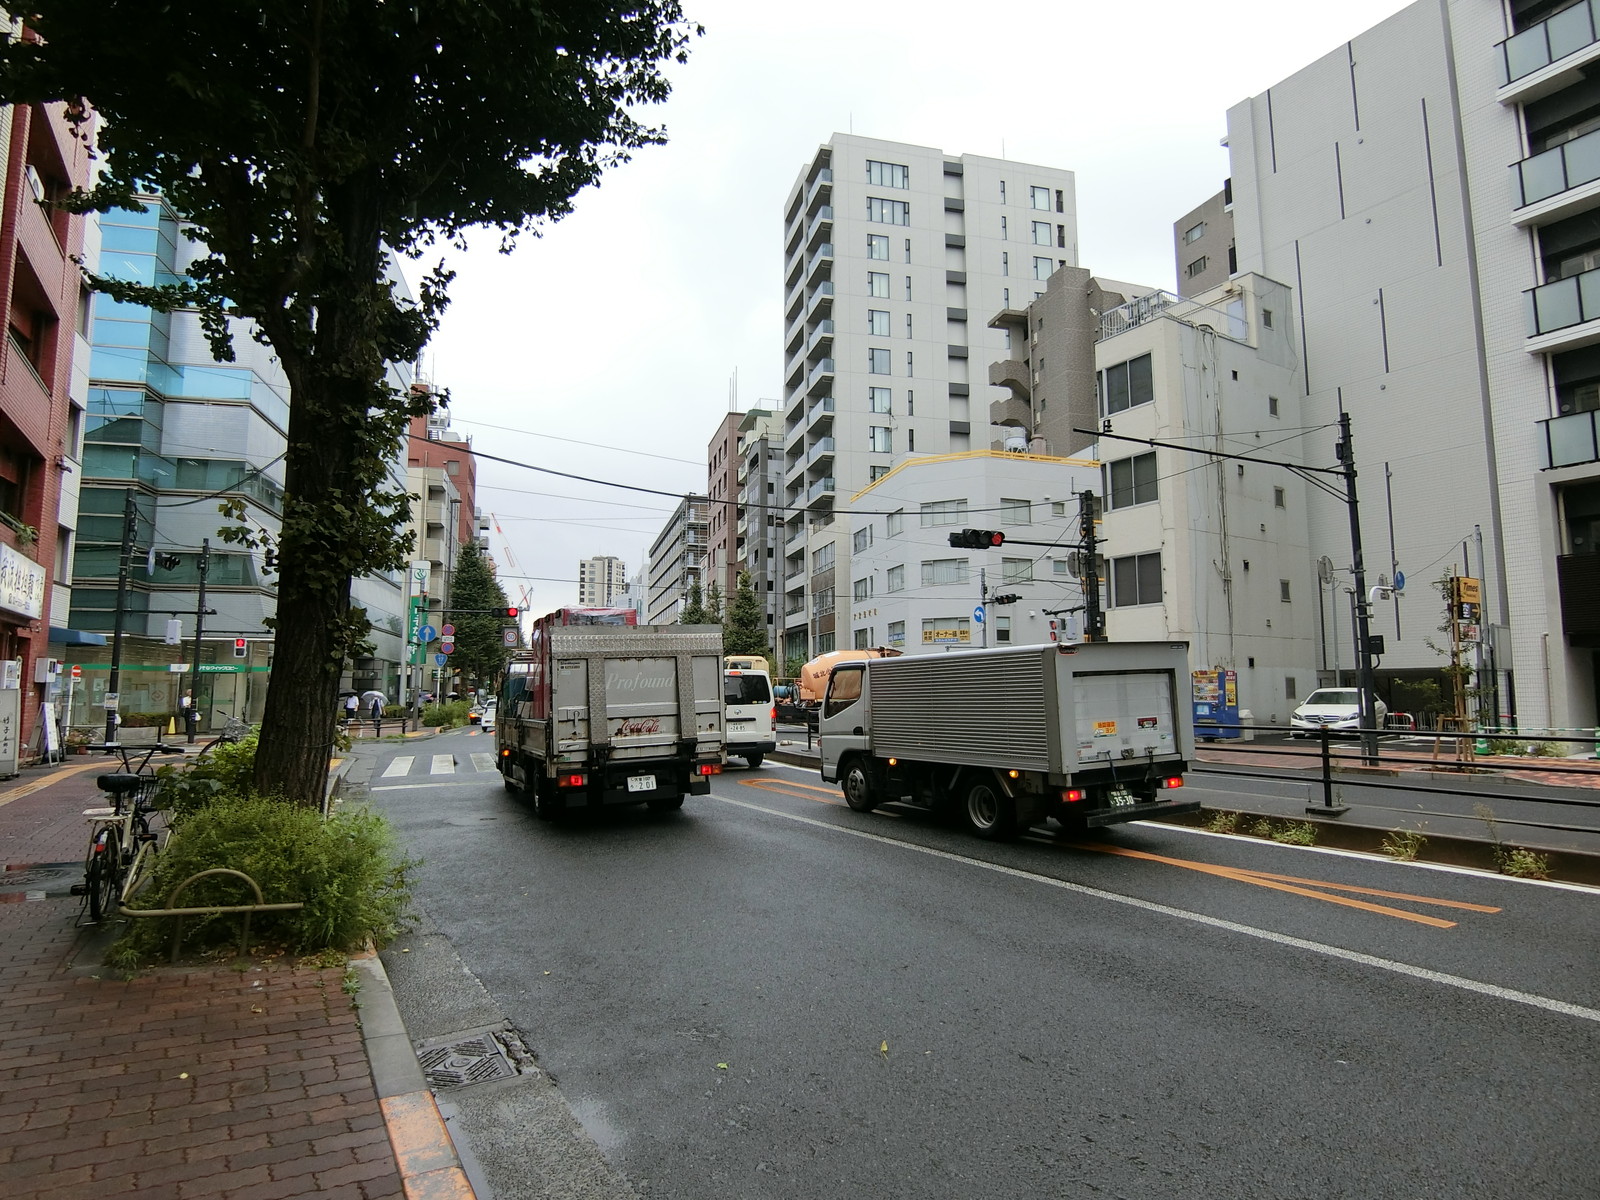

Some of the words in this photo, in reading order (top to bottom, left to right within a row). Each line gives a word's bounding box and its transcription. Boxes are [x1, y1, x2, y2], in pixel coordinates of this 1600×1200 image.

[1463, 582, 1478, 592] Times
[606, 671, 676, 691] Profound
[1114, 795, 1134, 806] 35-30
